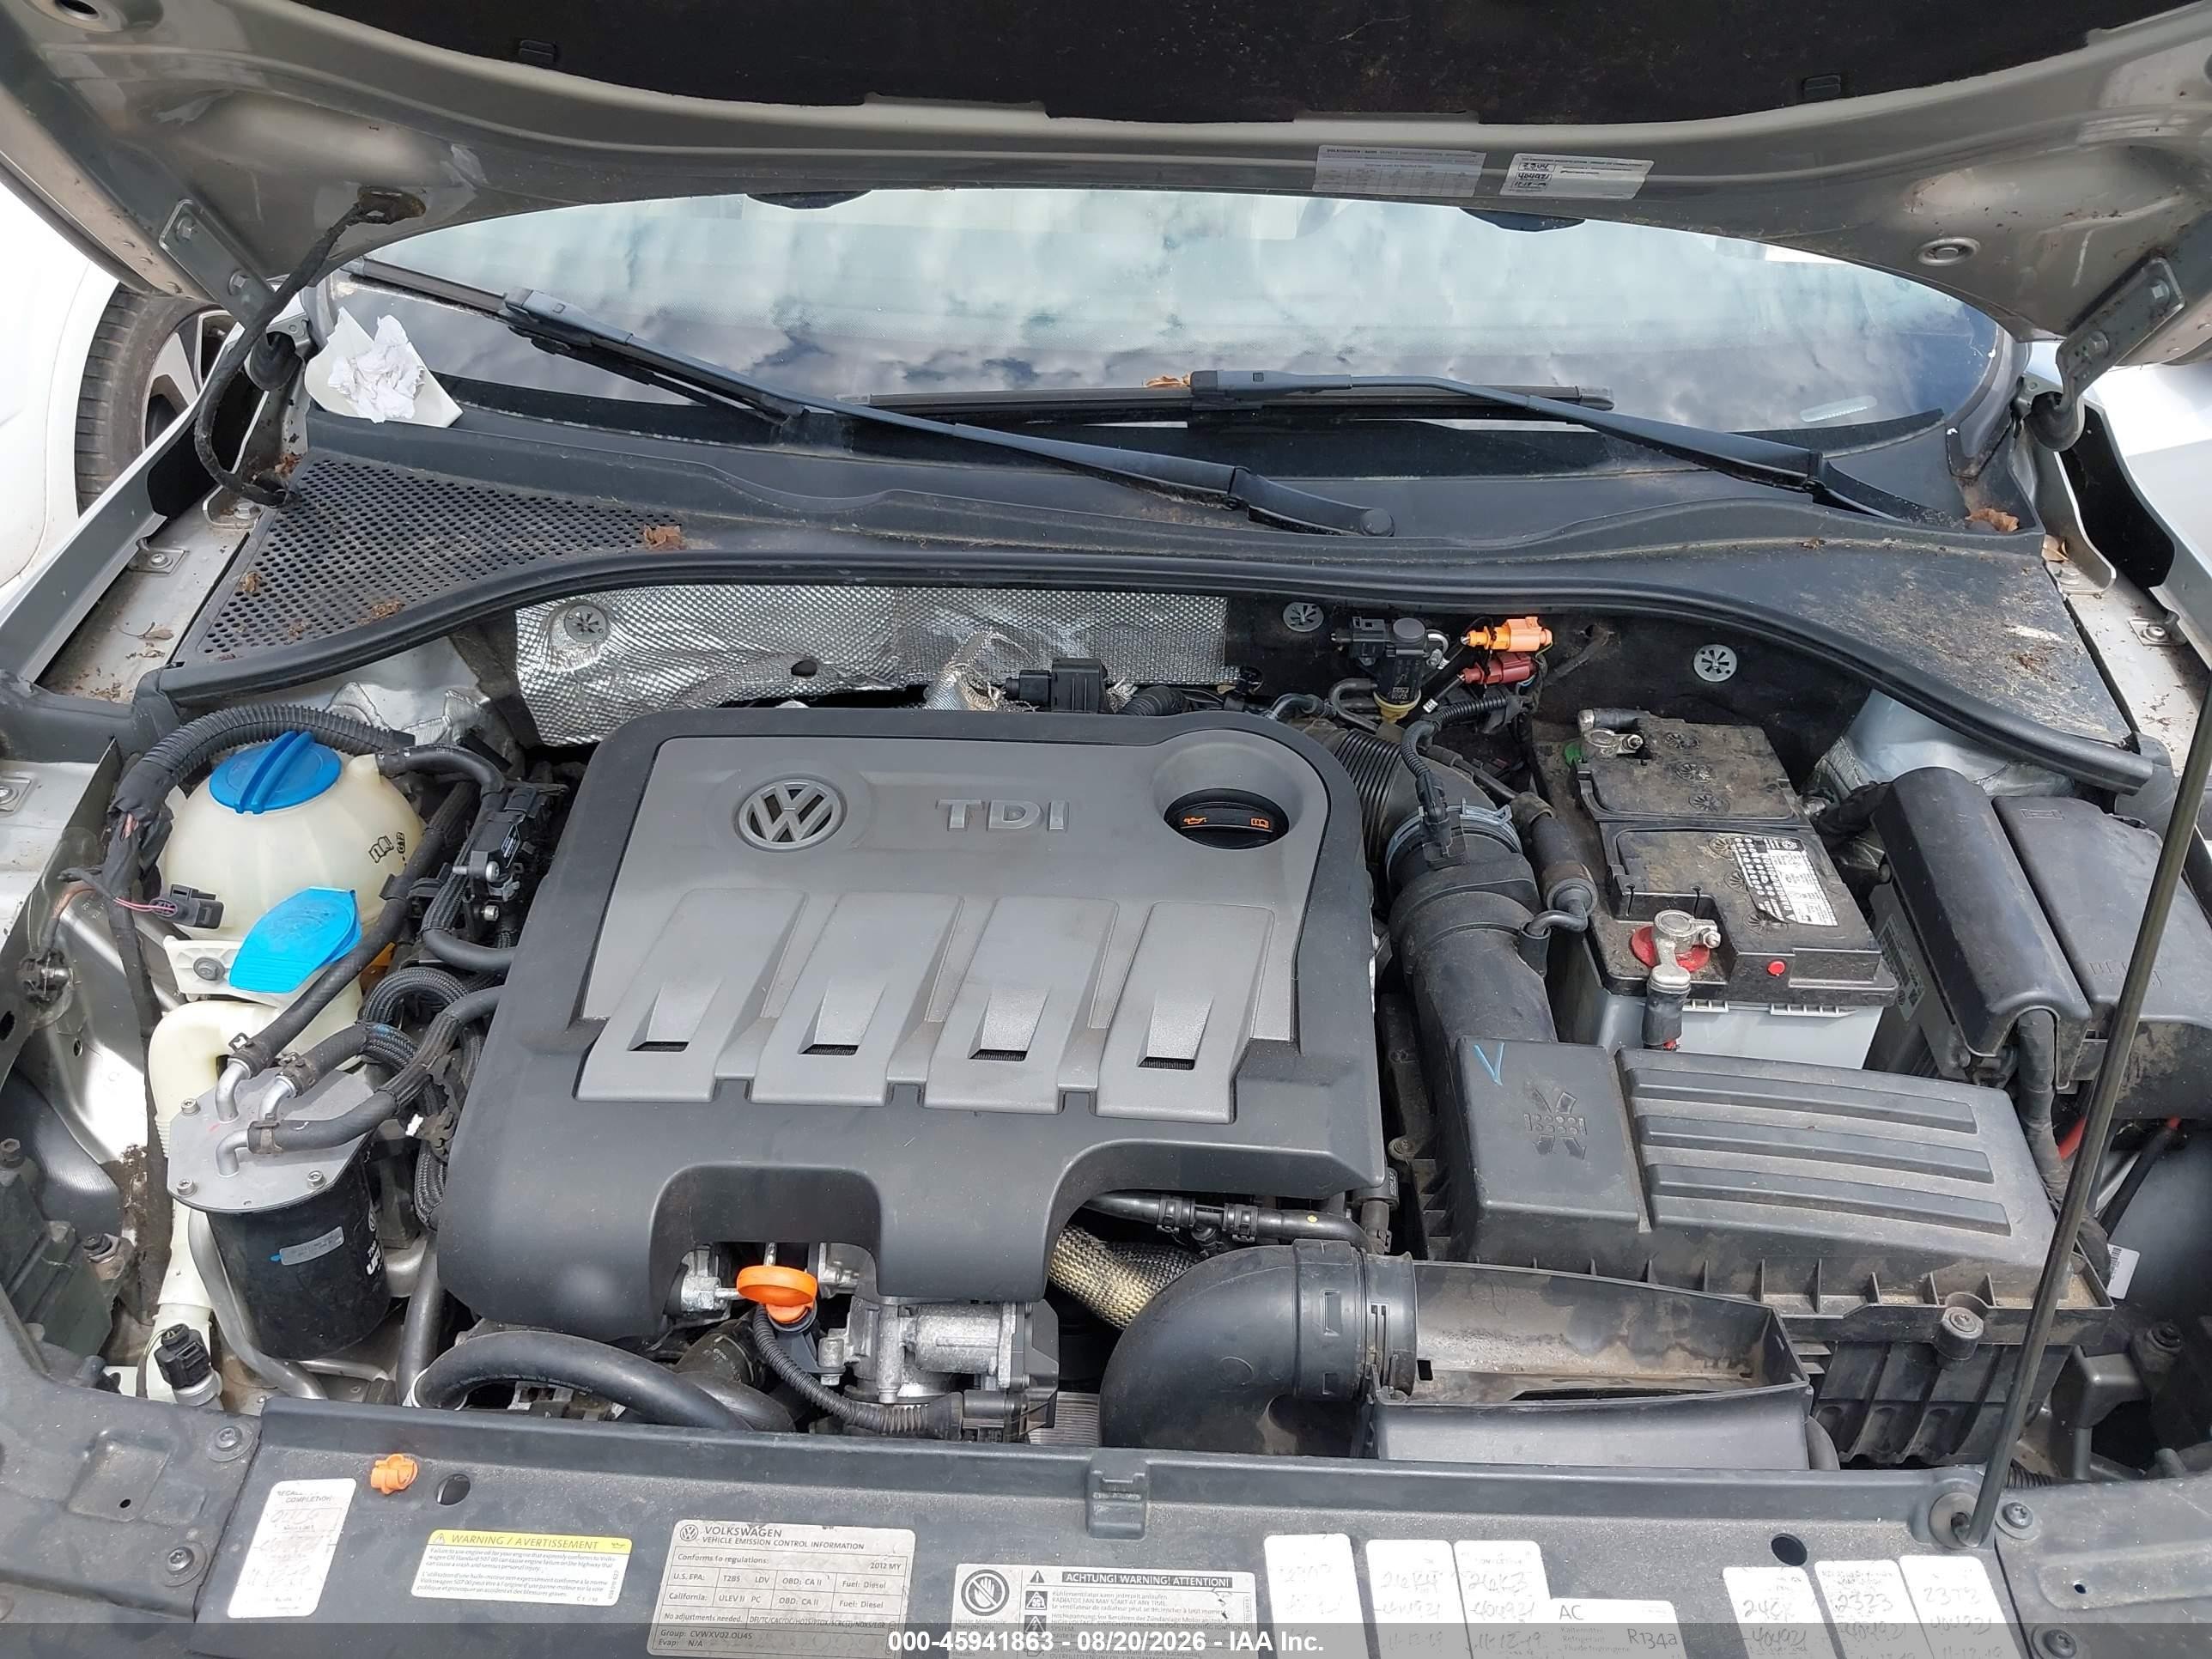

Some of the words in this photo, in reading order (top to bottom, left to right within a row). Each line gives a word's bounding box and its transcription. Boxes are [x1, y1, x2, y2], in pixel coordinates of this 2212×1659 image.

[937, 799, 1069, 831] TDI
[704, 1526, 781, 1537] VOLKSWAGEN
[451, 1534, 505, 1544] WARNING
[514, 1537, 598, 1549] AVERTISSEMENT
[811, 1540, 864, 1549] INFORMATION
[1066, 1573, 1116, 1583] ACHTUNG!
[1121, 1574, 1170, 1584] WARNING!
[1173, 1576, 1229, 1586] ATTENTION!
[674, 1613, 715, 1622] adjustments
[1559, 1604, 1584, 1620] AC
[1627, 1628, 1678, 1650] R134a
